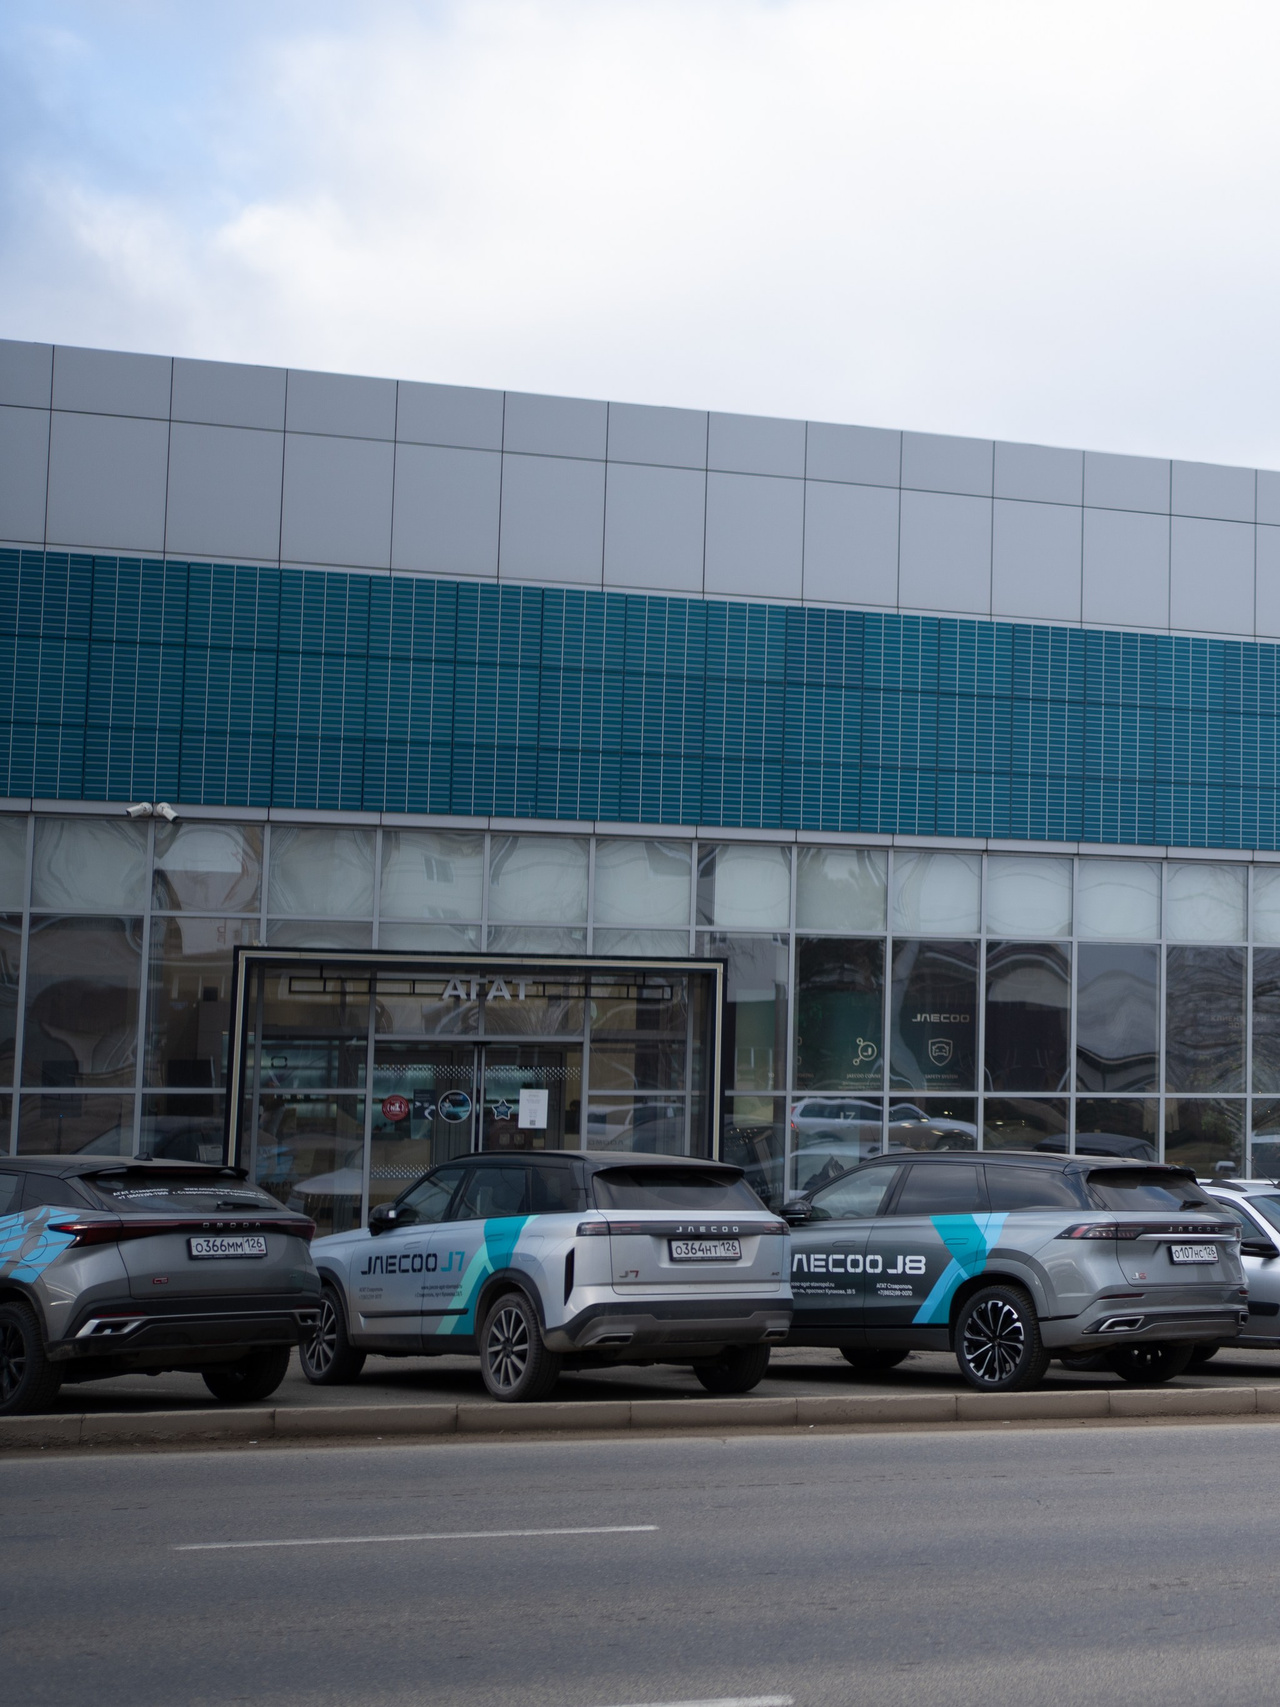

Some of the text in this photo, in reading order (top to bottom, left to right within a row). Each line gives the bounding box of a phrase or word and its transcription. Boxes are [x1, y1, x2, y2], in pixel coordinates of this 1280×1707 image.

[442, 978, 534, 1001] АГАТ
[912, 1013, 970, 1023] JAECOO
[676, 1225, 740, 1233] JAECOO
[245, 1237, 263, 1249] 126
[720, 1241, 737, 1252] 126
[361, 1251, 465, 1275] JAECOO J7
[792, 1254, 927, 1275] AECOO J8
[619, 1270, 639, 1278] J7
